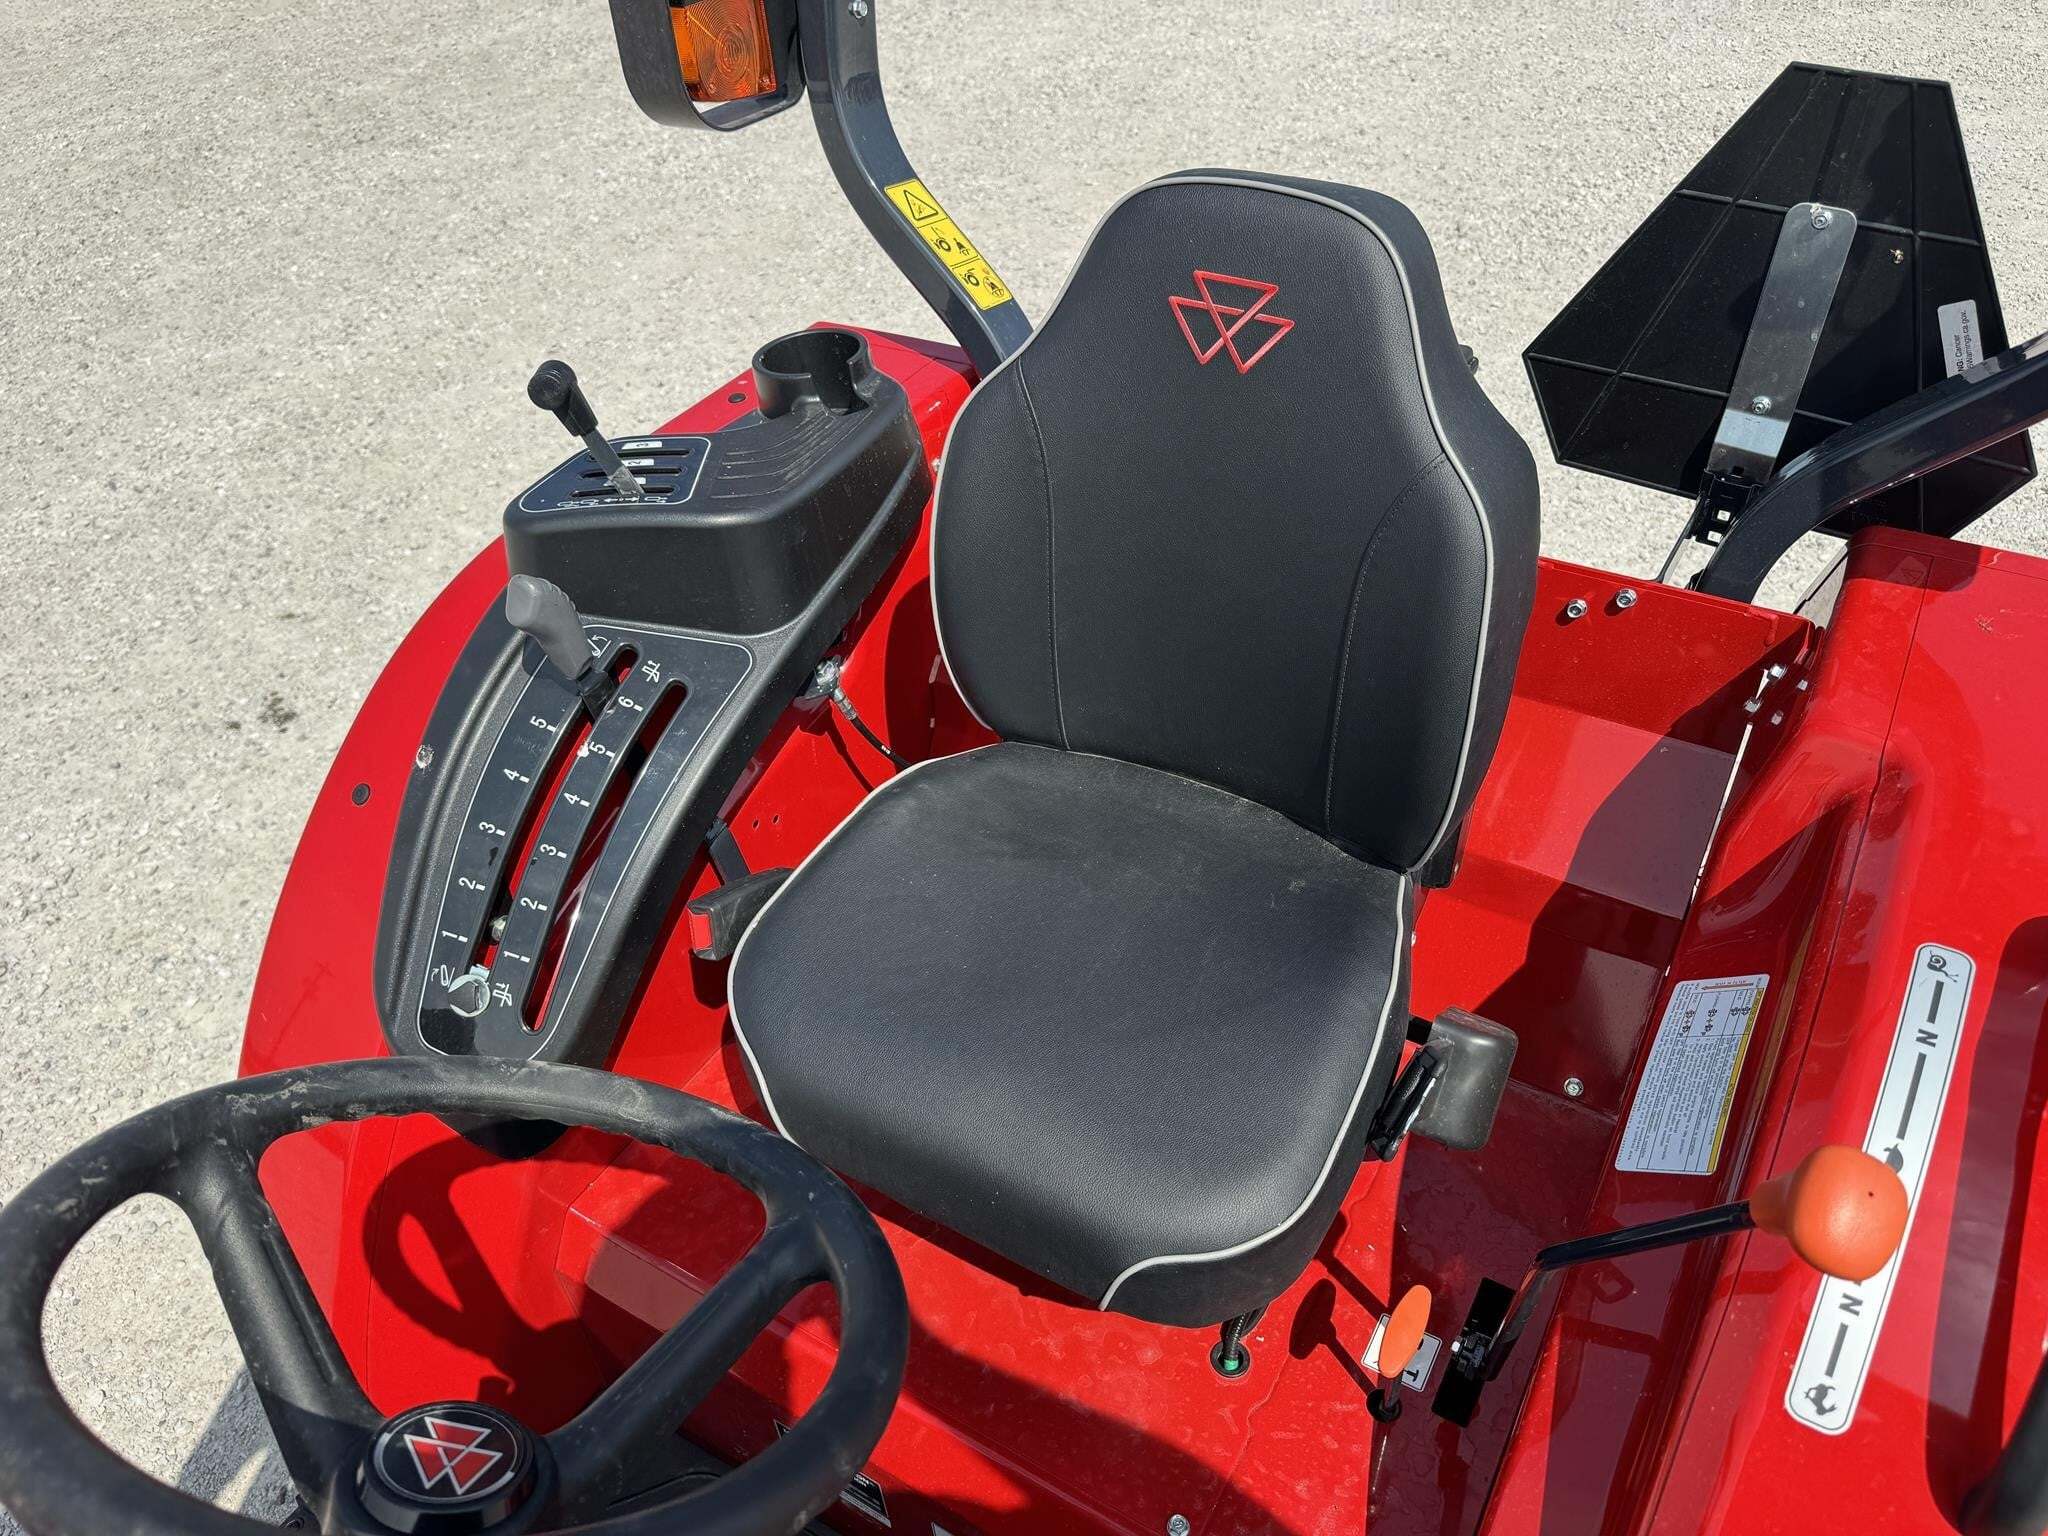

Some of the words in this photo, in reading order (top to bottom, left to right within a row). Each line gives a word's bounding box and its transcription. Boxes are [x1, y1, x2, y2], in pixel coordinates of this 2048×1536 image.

[1954, 334, 1963, 357] Cancer
[618, 696, 634, 708] 6
[529, 715, 547, 729] 5
[588, 741, 606, 754] 5
[503, 768, 520, 781] 4
[563, 792, 580, 805] 4
[478, 821, 496, 834] 3
[539, 843, 557, 856] 3
[458, 876, 476, 890] 2
[520, 897, 538, 910] 2
[441, 930, 458, 939] 1
[503, 950, 520, 959] 1
[1915, 1028, 1939, 1048] N
[1839, 1293, 1863, 1316] N
